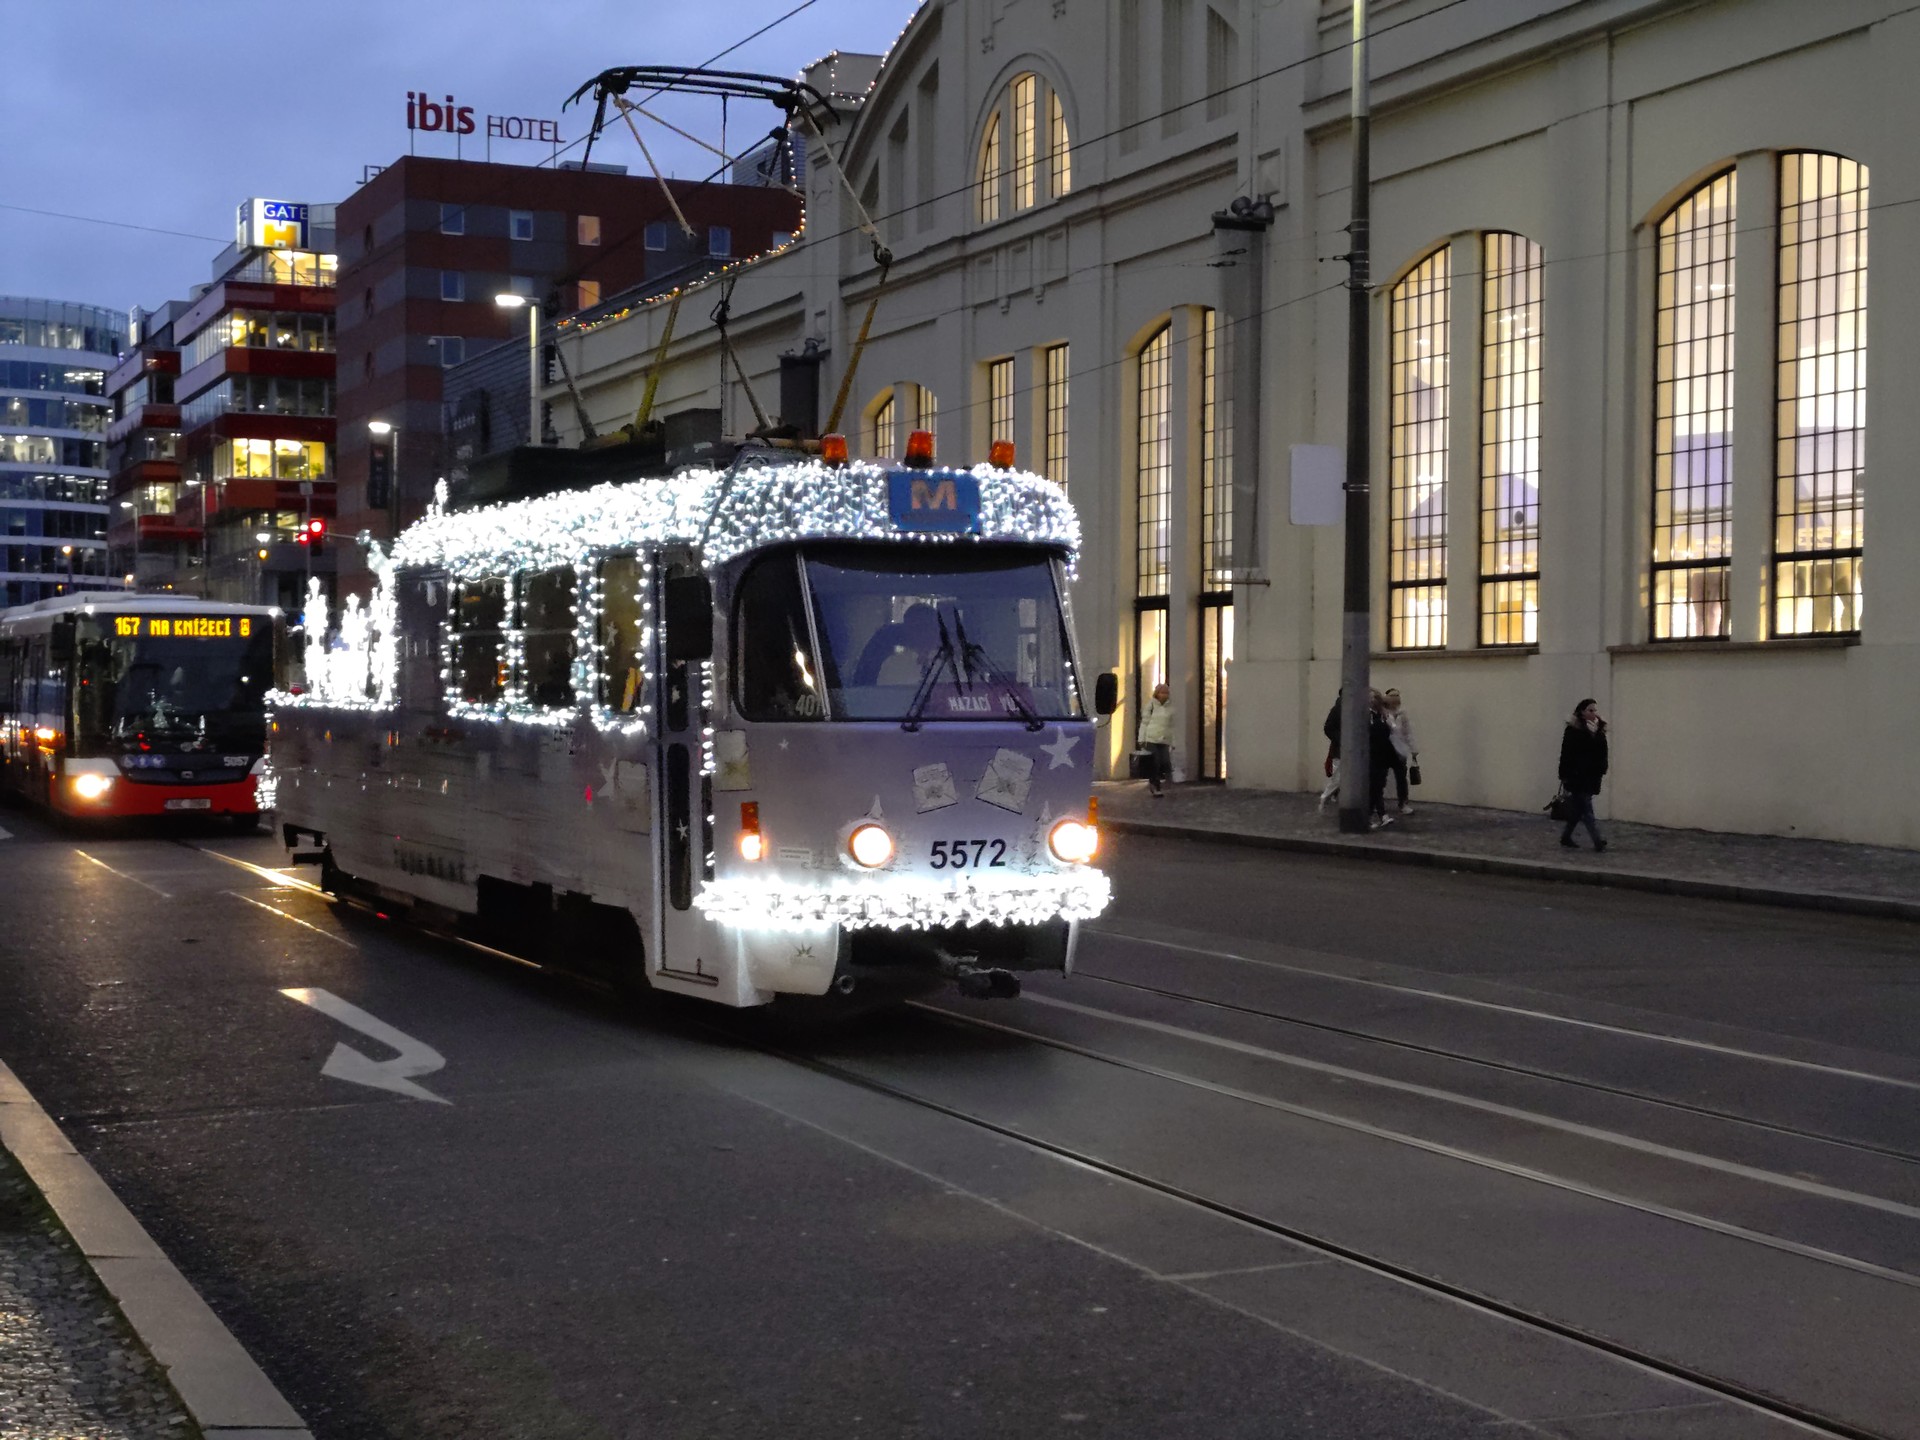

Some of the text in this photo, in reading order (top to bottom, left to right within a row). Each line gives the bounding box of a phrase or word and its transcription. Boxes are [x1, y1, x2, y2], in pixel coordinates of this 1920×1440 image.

[407, 91, 566, 143] ibis HOTEL
[264, 204, 308, 219] GATE
[911, 479, 957, 510] M
[115, 617, 231, 636] 167 NA KNÍŽECÍ
[930, 839, 1007, 869] 5572
